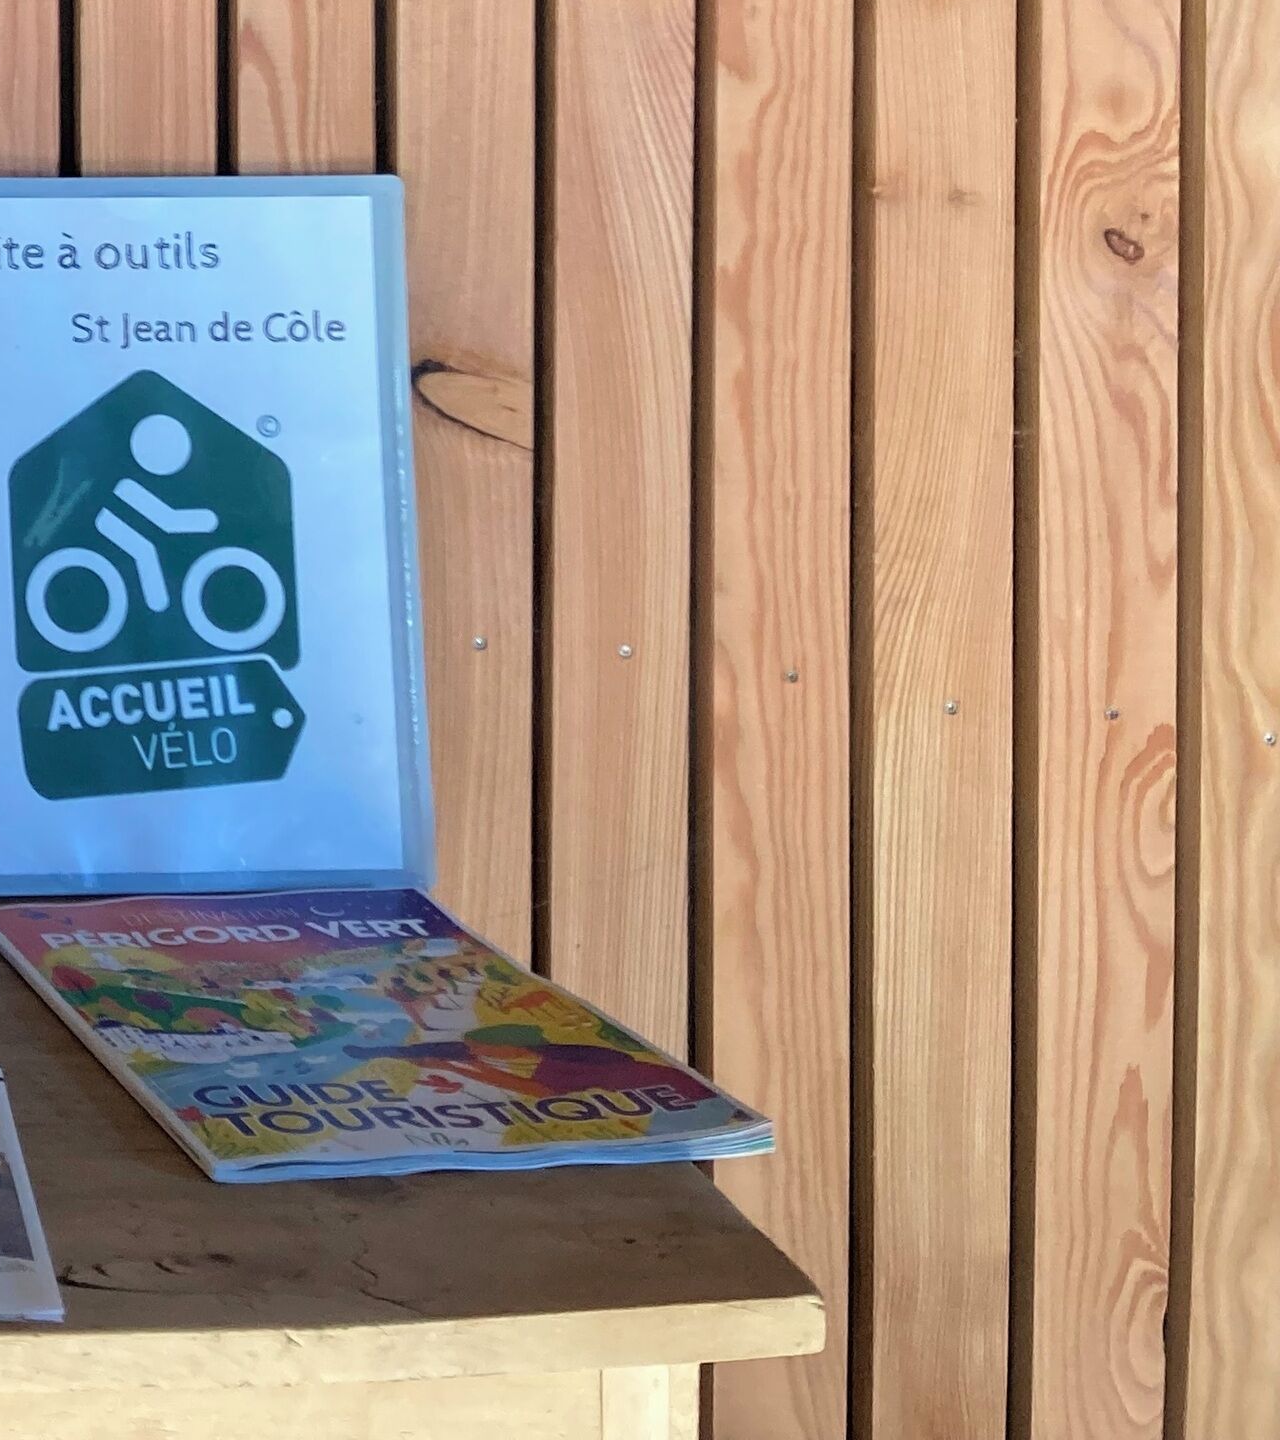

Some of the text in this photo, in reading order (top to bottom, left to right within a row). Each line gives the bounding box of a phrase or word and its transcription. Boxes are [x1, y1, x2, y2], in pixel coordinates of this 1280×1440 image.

[57, 232, 81, 270] à
[93, 231, 220, 270] outils
[71, 310, 347, 350] St Jean de Côle
[46, 674, 256, 732] ACCUEIL
[132, 722, 238, 771] VÉLO
[41, 919, 431, 951] PÉRIGORD VERT
[122, 907, 297, 927] DESTINATION
[193, 1078, 411, 1111] GUIDE
[207, 1084, 700, 1138] TOURISTIQUE
